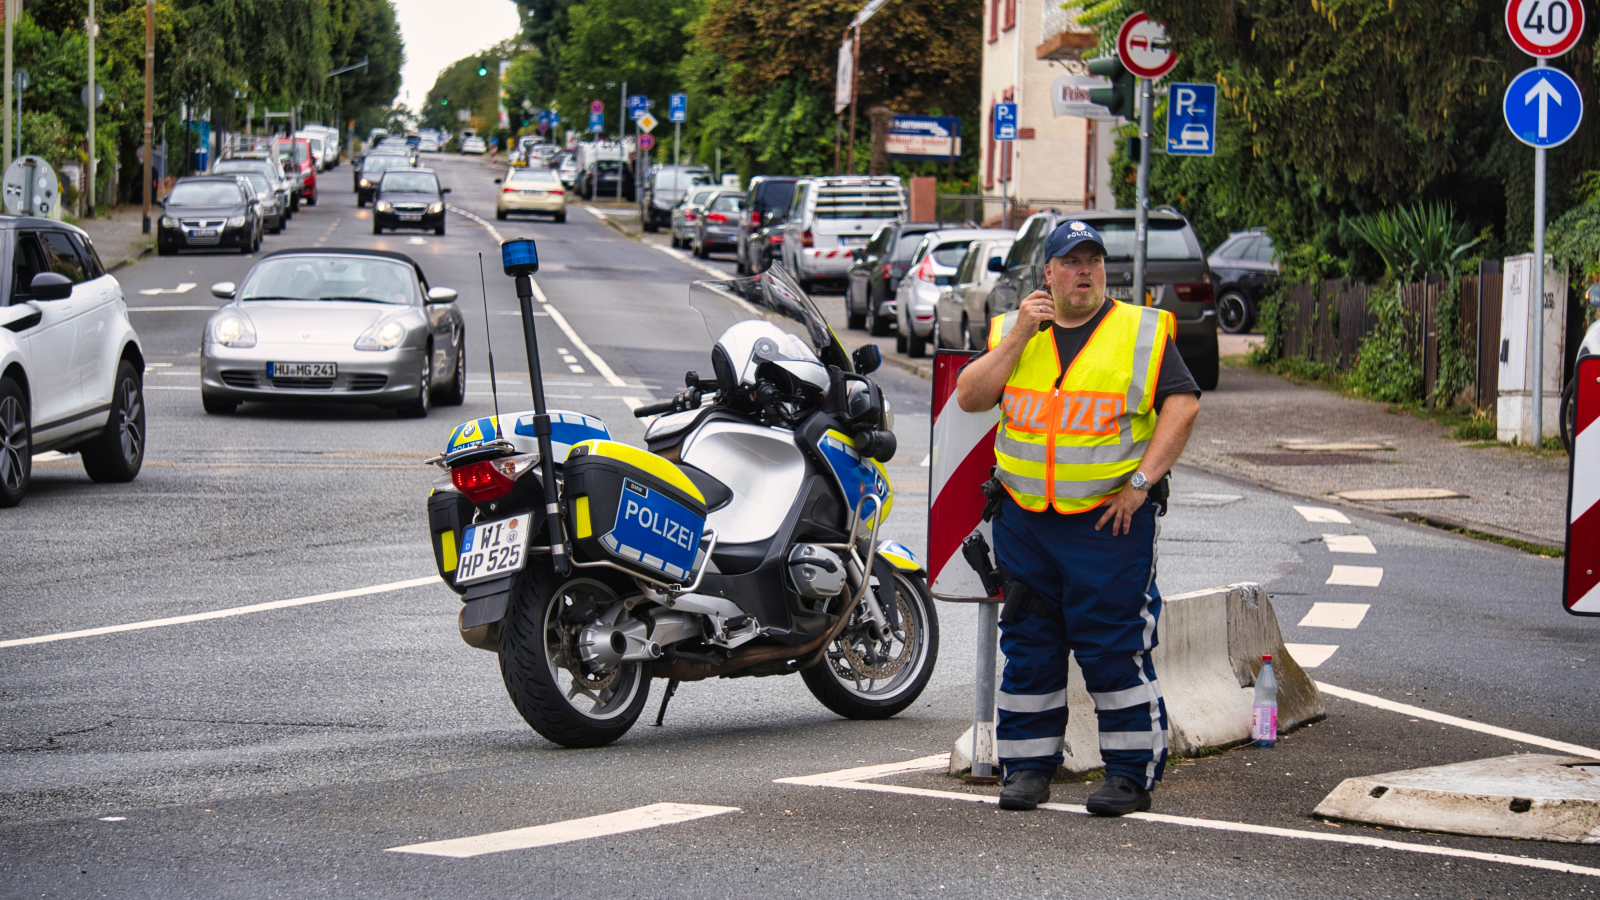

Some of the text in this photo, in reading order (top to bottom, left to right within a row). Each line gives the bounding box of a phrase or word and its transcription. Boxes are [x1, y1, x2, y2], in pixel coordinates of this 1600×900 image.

[1523, 0, 1568, 36] 40
[998, 105, 1009, 121] P
[1176, 88, 1197, 117] P
[275, 364, 335, 376] HU MG 241
[1002, 393, 1122, 432] POLIZEI
[630, 483, 643, 493] BMW
[480, 523, 502, 550] WI
[624, 499, 694, 551] POLIZEI
[459, 543, 521, 578] HP 525
